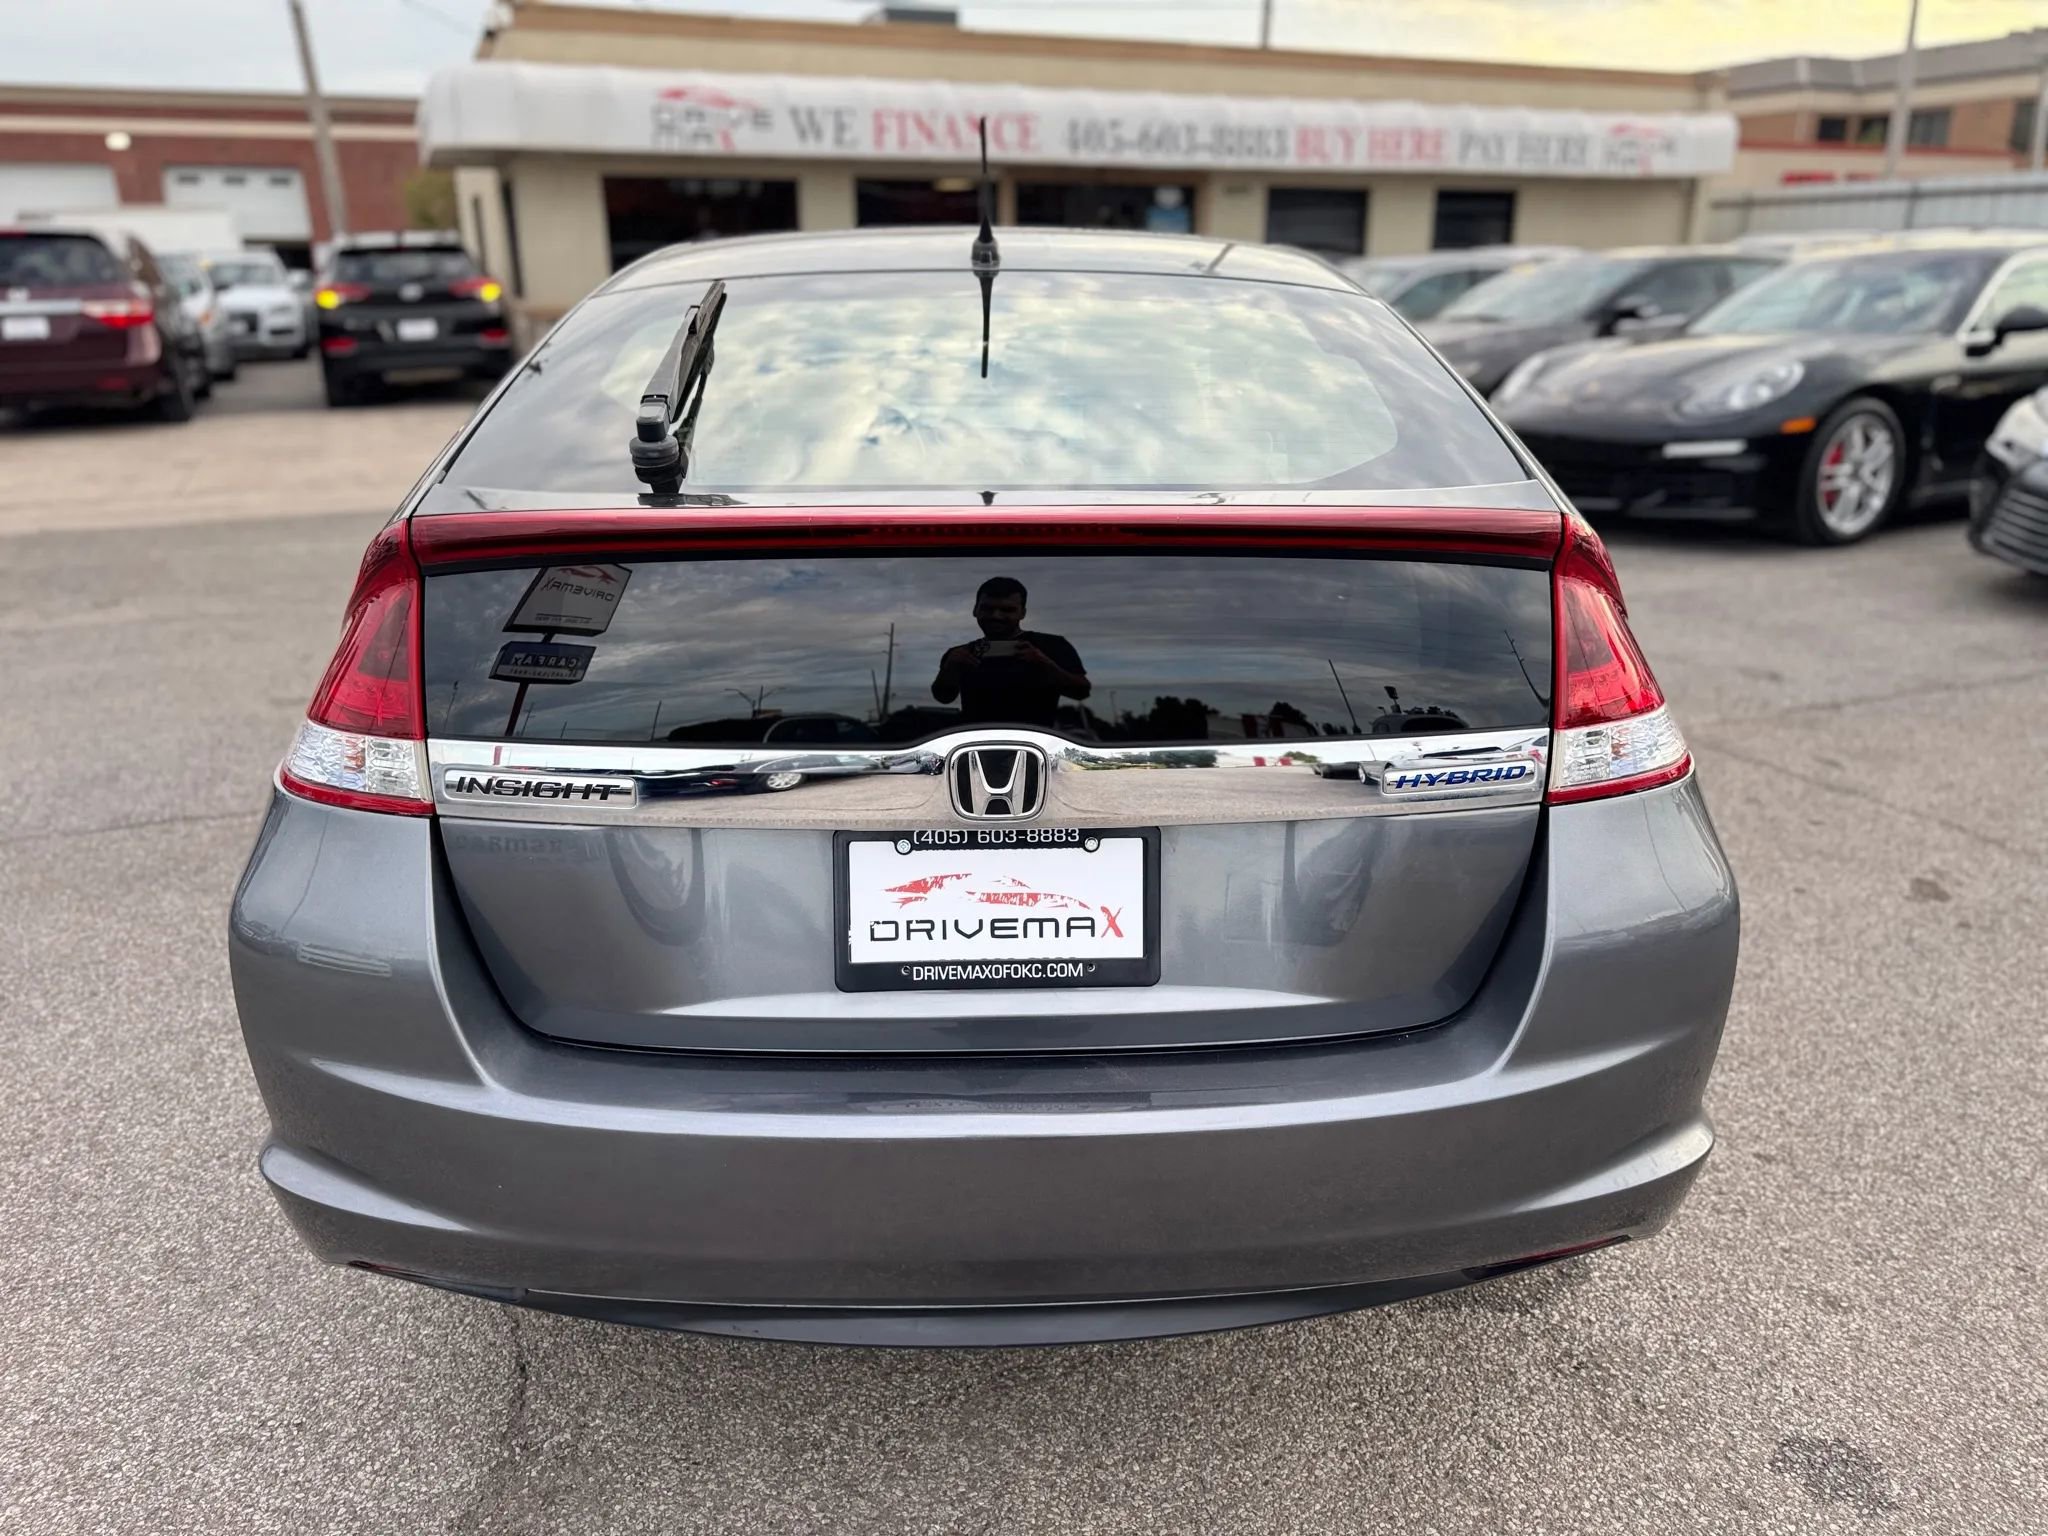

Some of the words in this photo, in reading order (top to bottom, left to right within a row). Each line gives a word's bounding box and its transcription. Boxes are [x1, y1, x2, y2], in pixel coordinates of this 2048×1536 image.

[789, 105, 860, 147] WE
[872, 108, 1038, 151] FINANCE
[1296, 127, 1365, 164] BUY
[1367, 128, 1447, 164] HERE
[1458, 129, 1510, 166] PAY
[1515, 131, 1592, 167] HERE
[456, 776, 621, 801] INSIGHT
[1396, 766, 1527, 789] HYBRID
[913, 829, 968, 845] (405)
[977, 828, 1080, 844] 603-8883
[869, 905, 1124, 942] DRIVEMAX
[912, 962, 1083, 981] DRIVEMAXOFOKC.COM
